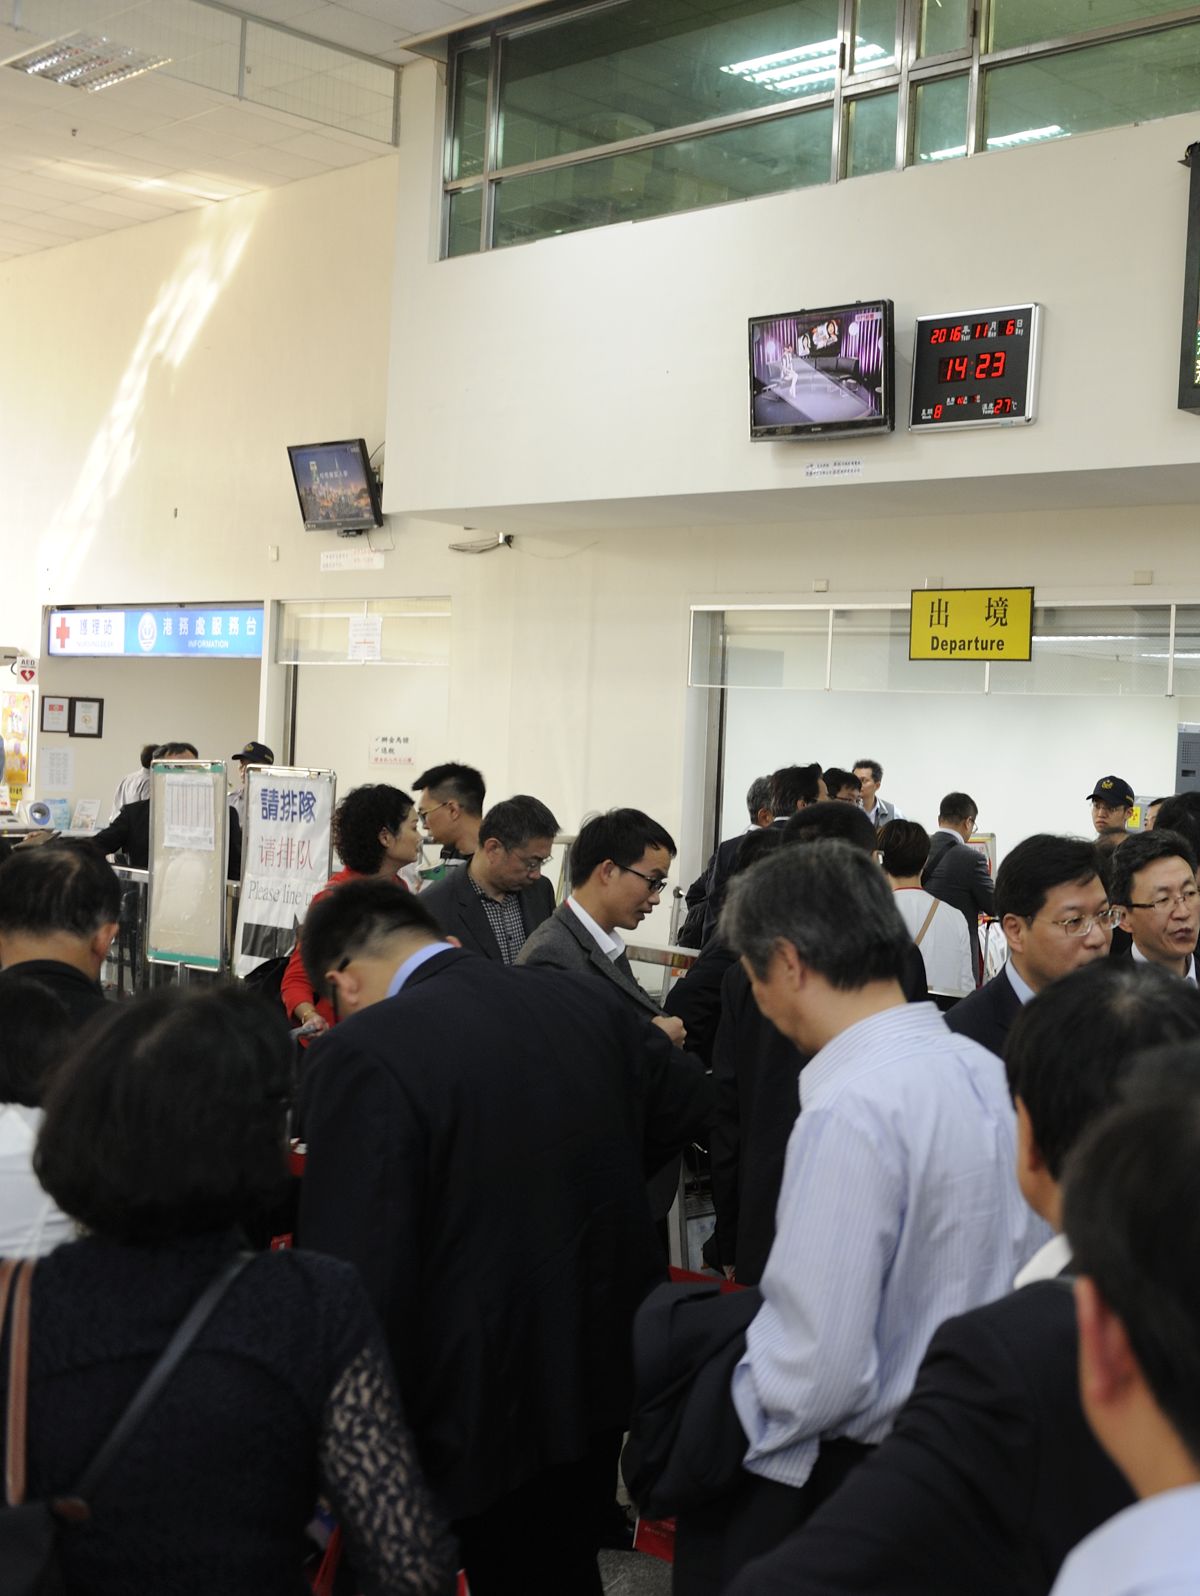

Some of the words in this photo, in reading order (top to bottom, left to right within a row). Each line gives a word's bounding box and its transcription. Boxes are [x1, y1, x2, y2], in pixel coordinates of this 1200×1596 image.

[930, 326, 962, 344] 2016
[1005, 320, 1015, 336] 6
[946, 351, 1006, 381] 14:23
[933, 404, 943, 419] 8
[162, 615, 257, 637] 港務處服務台
[187, 639, 229, 649] INFORMATION
[930, 635, 1005, 655] Departure
[260, 788, 317, 824] 請排隊
[258, 835, 313, 870] 请排队
[248, 880, 280, 903] Please
[282, 883, 302, 905] line
